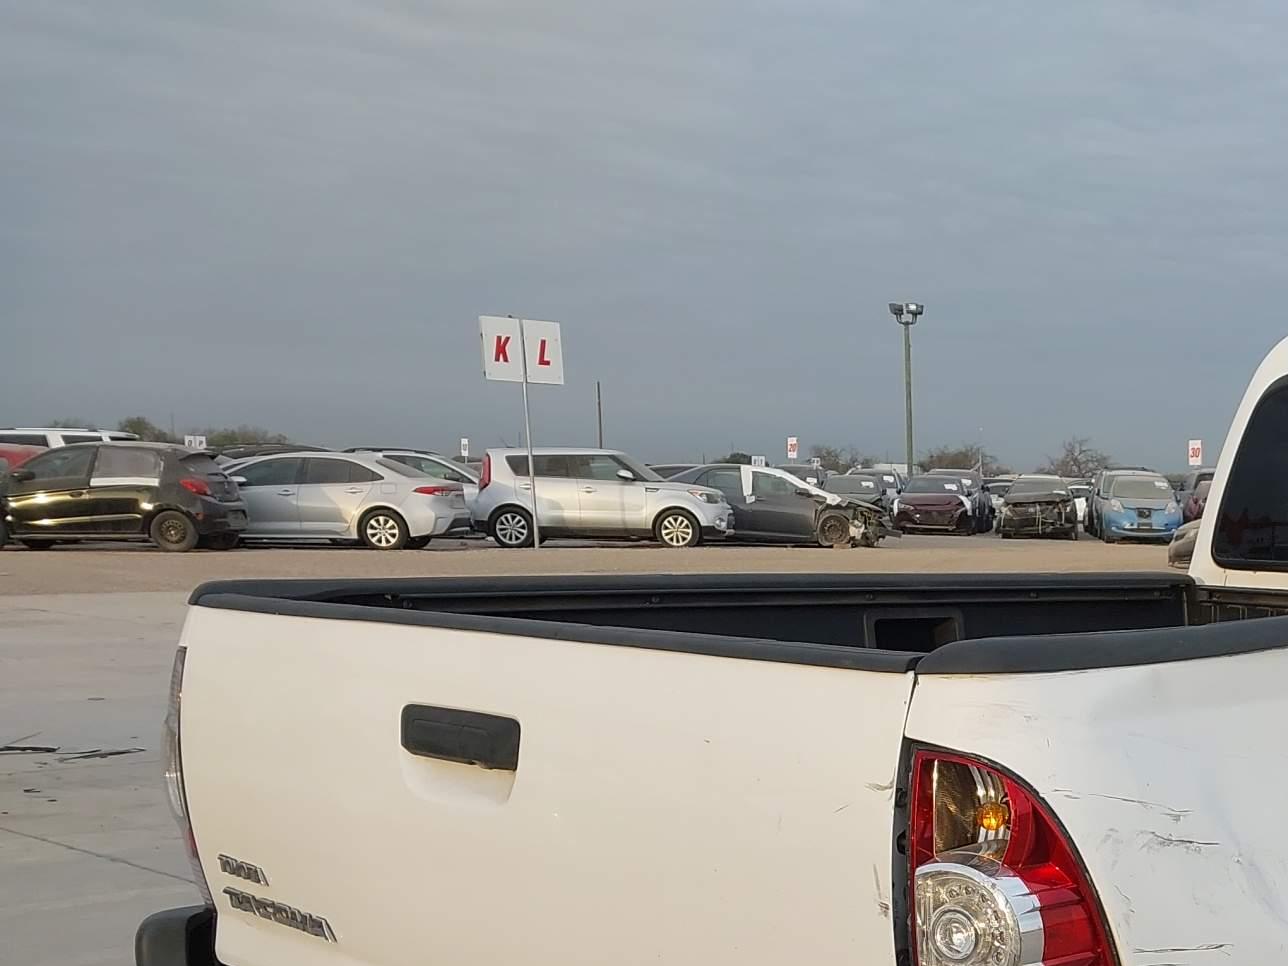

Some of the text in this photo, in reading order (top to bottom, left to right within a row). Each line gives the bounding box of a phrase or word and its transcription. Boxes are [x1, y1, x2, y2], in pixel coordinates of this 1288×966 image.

[494, 335, 551, 366] K L
[1190, 447, 1201, 458] 30
